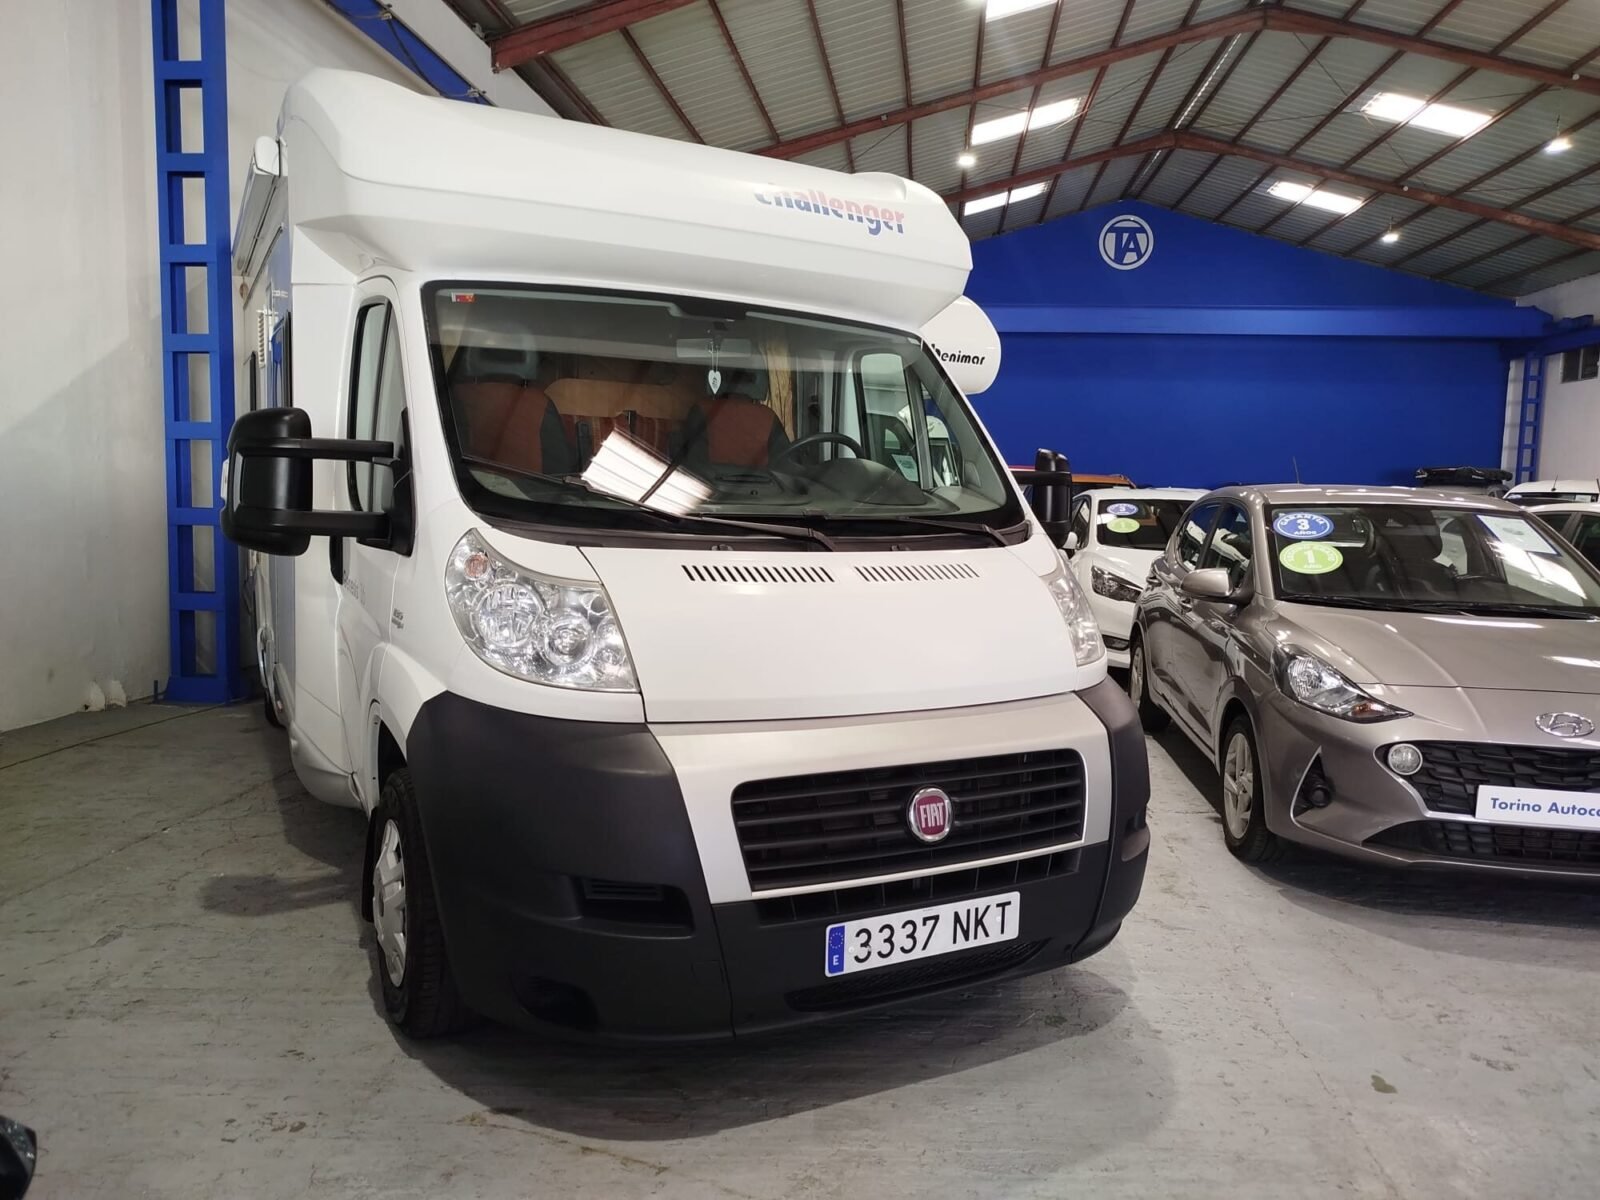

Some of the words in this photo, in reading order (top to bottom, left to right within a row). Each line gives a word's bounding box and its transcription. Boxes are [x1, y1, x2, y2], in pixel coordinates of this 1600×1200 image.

[754, 188, 905, 236] Challenger
[1296, 518, 1310, 531] 3
[1303, 549, 1316, 564] 1
[919, 802, 945, 829] FIAT
[1490, 797, 1542, 813] Torino
[832, 954, 840, 966] E
[853, 913, 940, 964] 3337
[952, 900, 1012, 945] NKT
